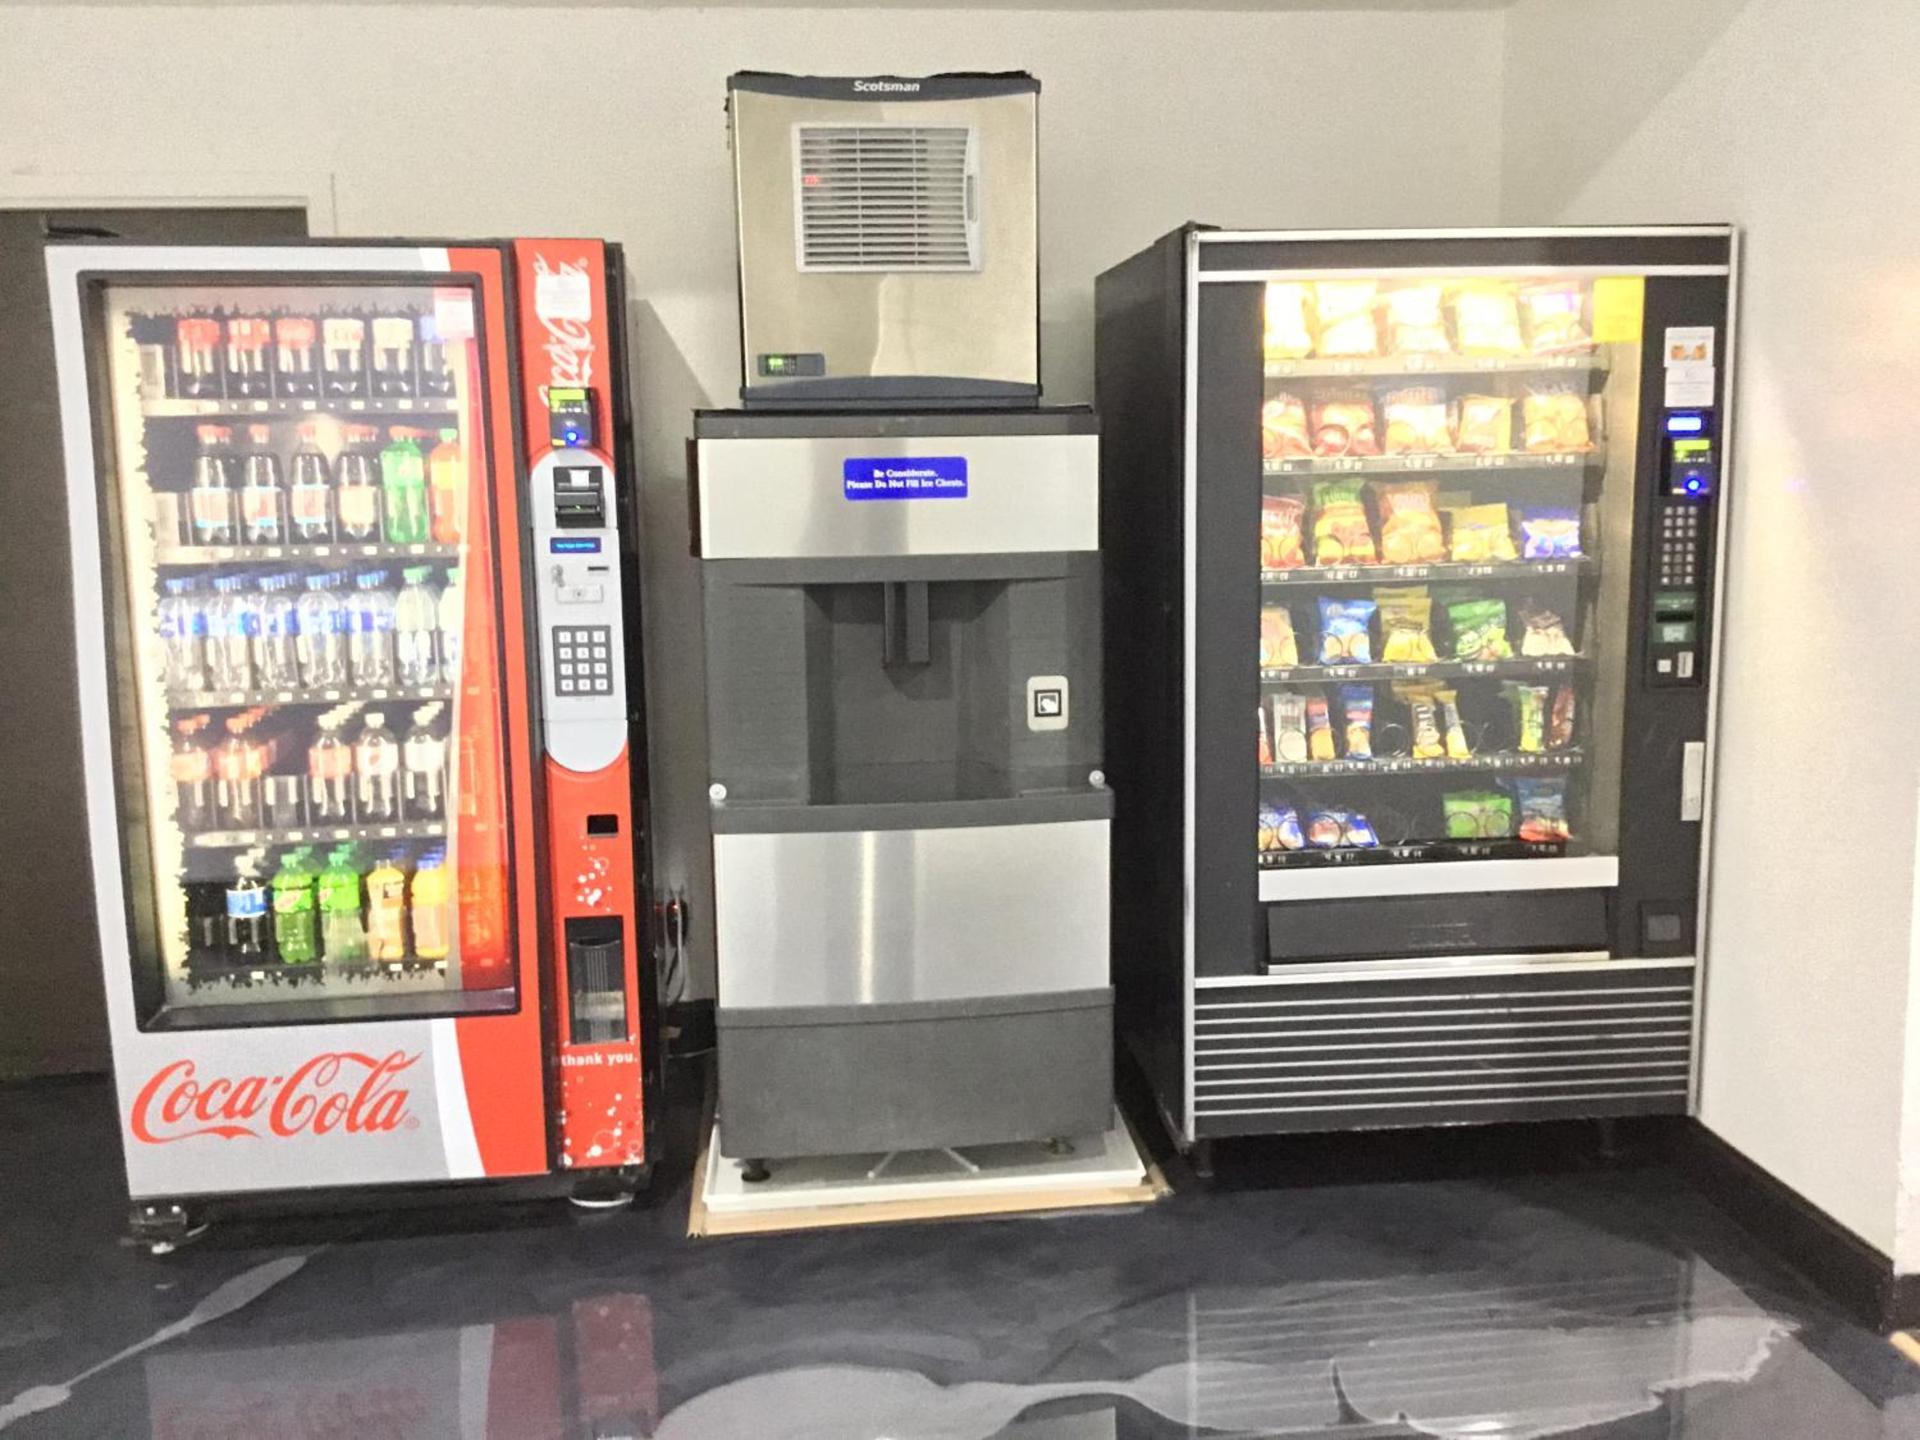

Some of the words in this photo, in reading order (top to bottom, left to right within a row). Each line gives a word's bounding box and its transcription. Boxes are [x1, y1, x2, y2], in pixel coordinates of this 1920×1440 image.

[853, 80, 920, 92] Scotsman
[561, 1052, 602, 1067] thank
[607, 1053, 638, 1067] you.
[131, 1049, 424, 1144] Coca-Cola
